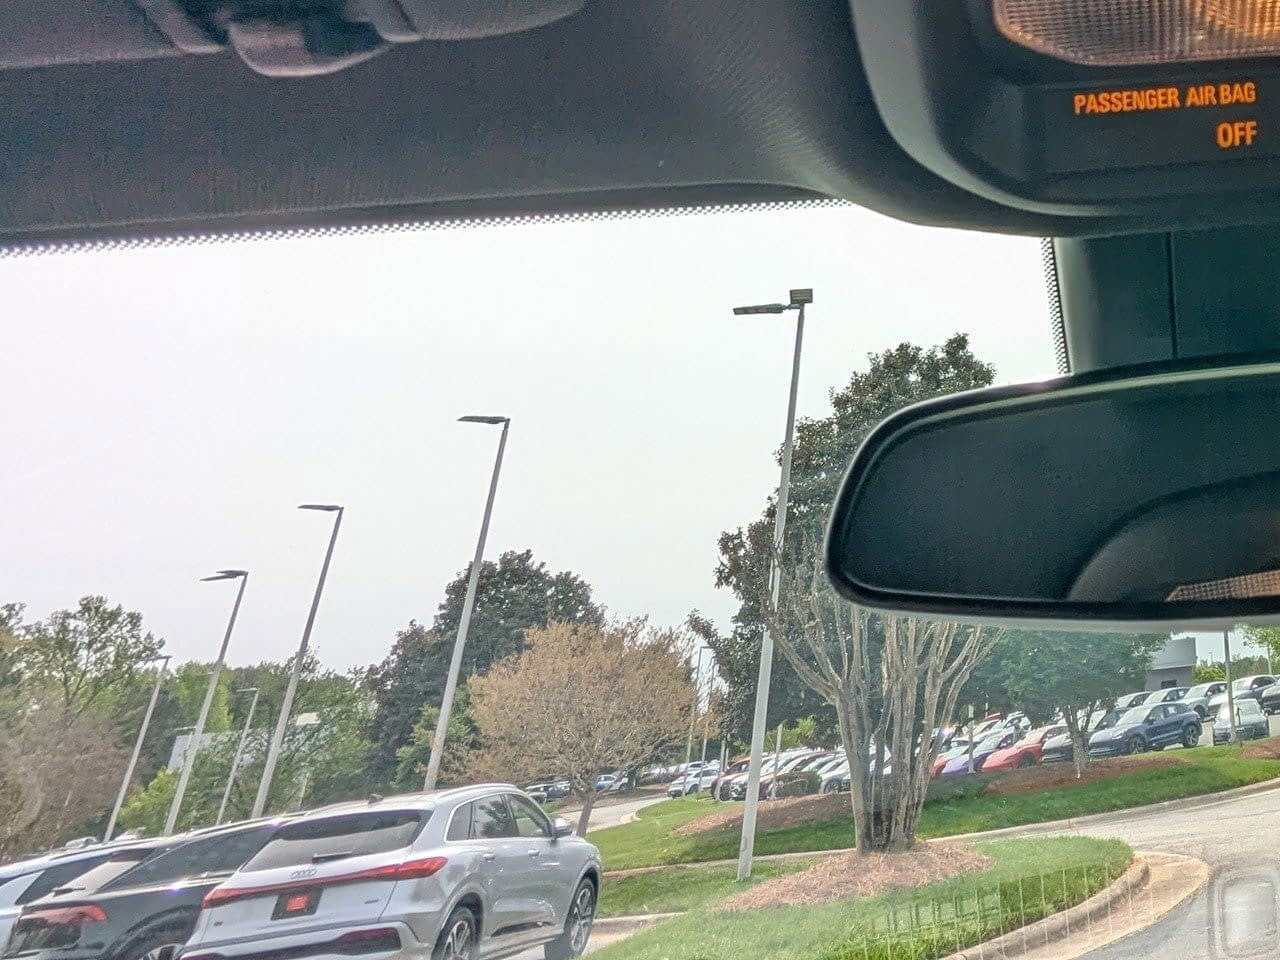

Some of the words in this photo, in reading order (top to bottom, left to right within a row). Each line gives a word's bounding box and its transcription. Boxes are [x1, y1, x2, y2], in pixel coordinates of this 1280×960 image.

[1073, 88, 1180, 115] PASSENGER
[1186, 85, 1217, 106] AIR
[1219, 82, 1257, 105] BAG
[1216, 122, 1258, 148] OFF
